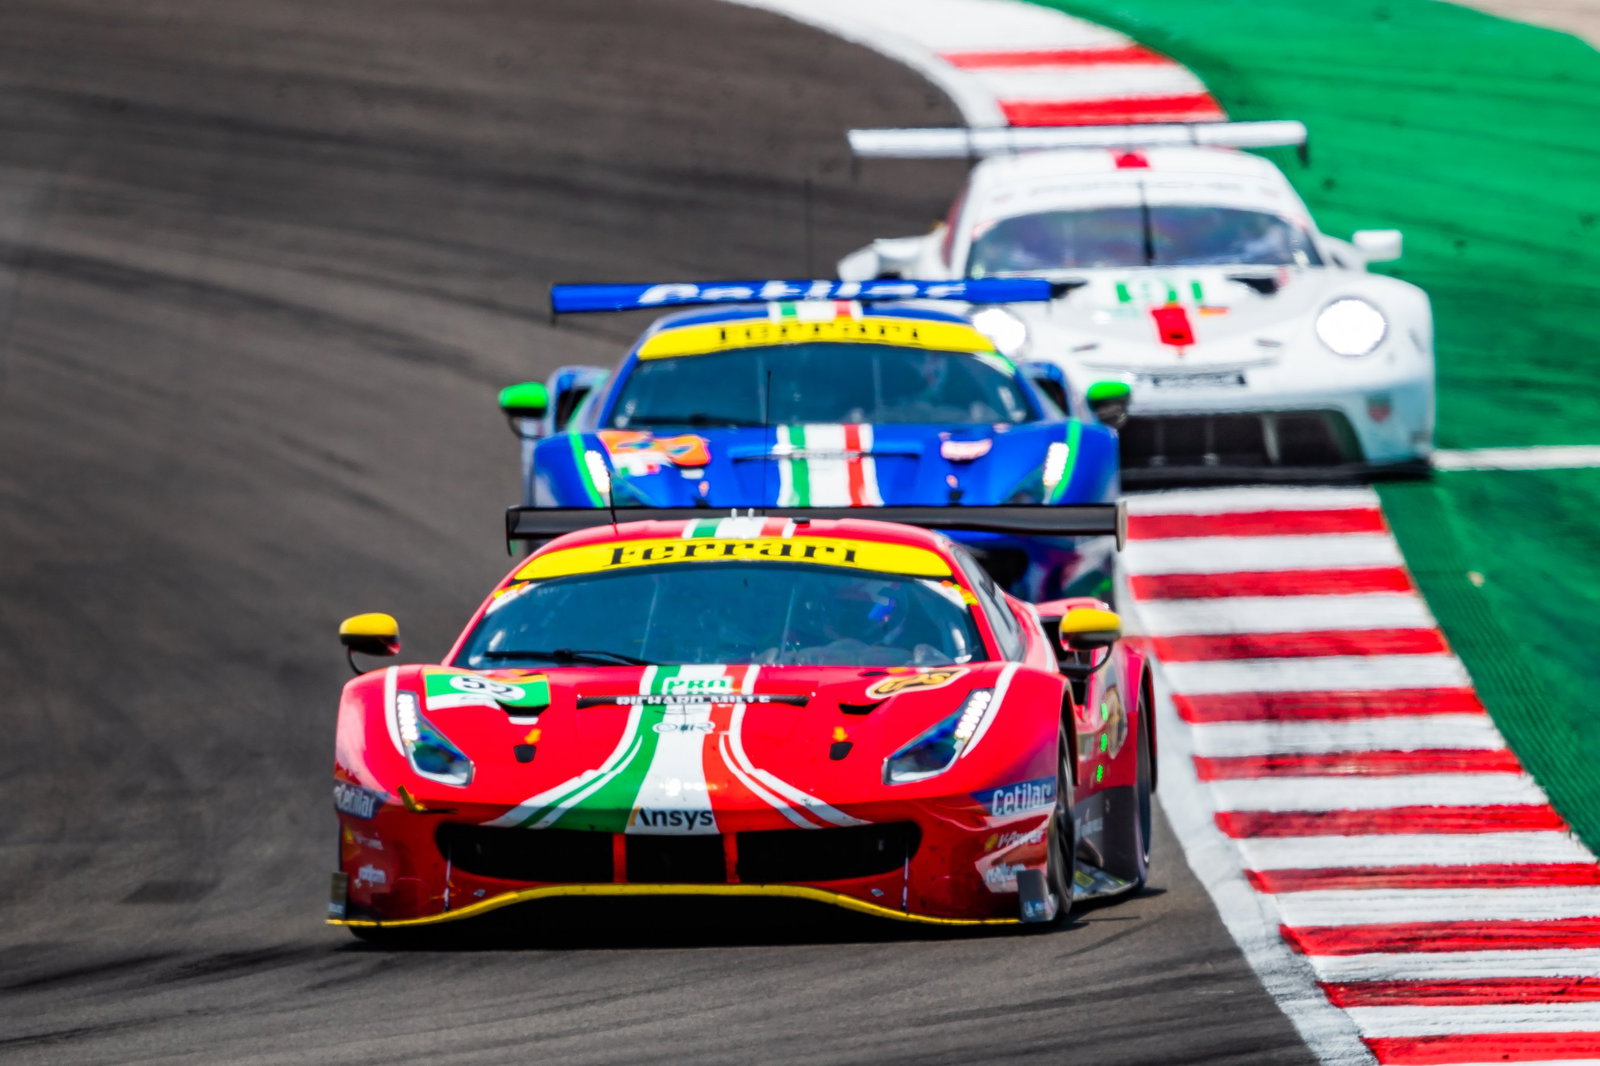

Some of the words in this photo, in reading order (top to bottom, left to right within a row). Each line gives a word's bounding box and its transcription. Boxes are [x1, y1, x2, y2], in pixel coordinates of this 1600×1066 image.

[603, 541, 859, 567] Ferrari
[666, 679, 727, 695] PRO
[616, 696, 704, 705] RICHARD
[710, 695, 771, 704] MILLE
[991, 781, 1052, 817] Cetilar
[628, 805, 714, 829] Ansys
